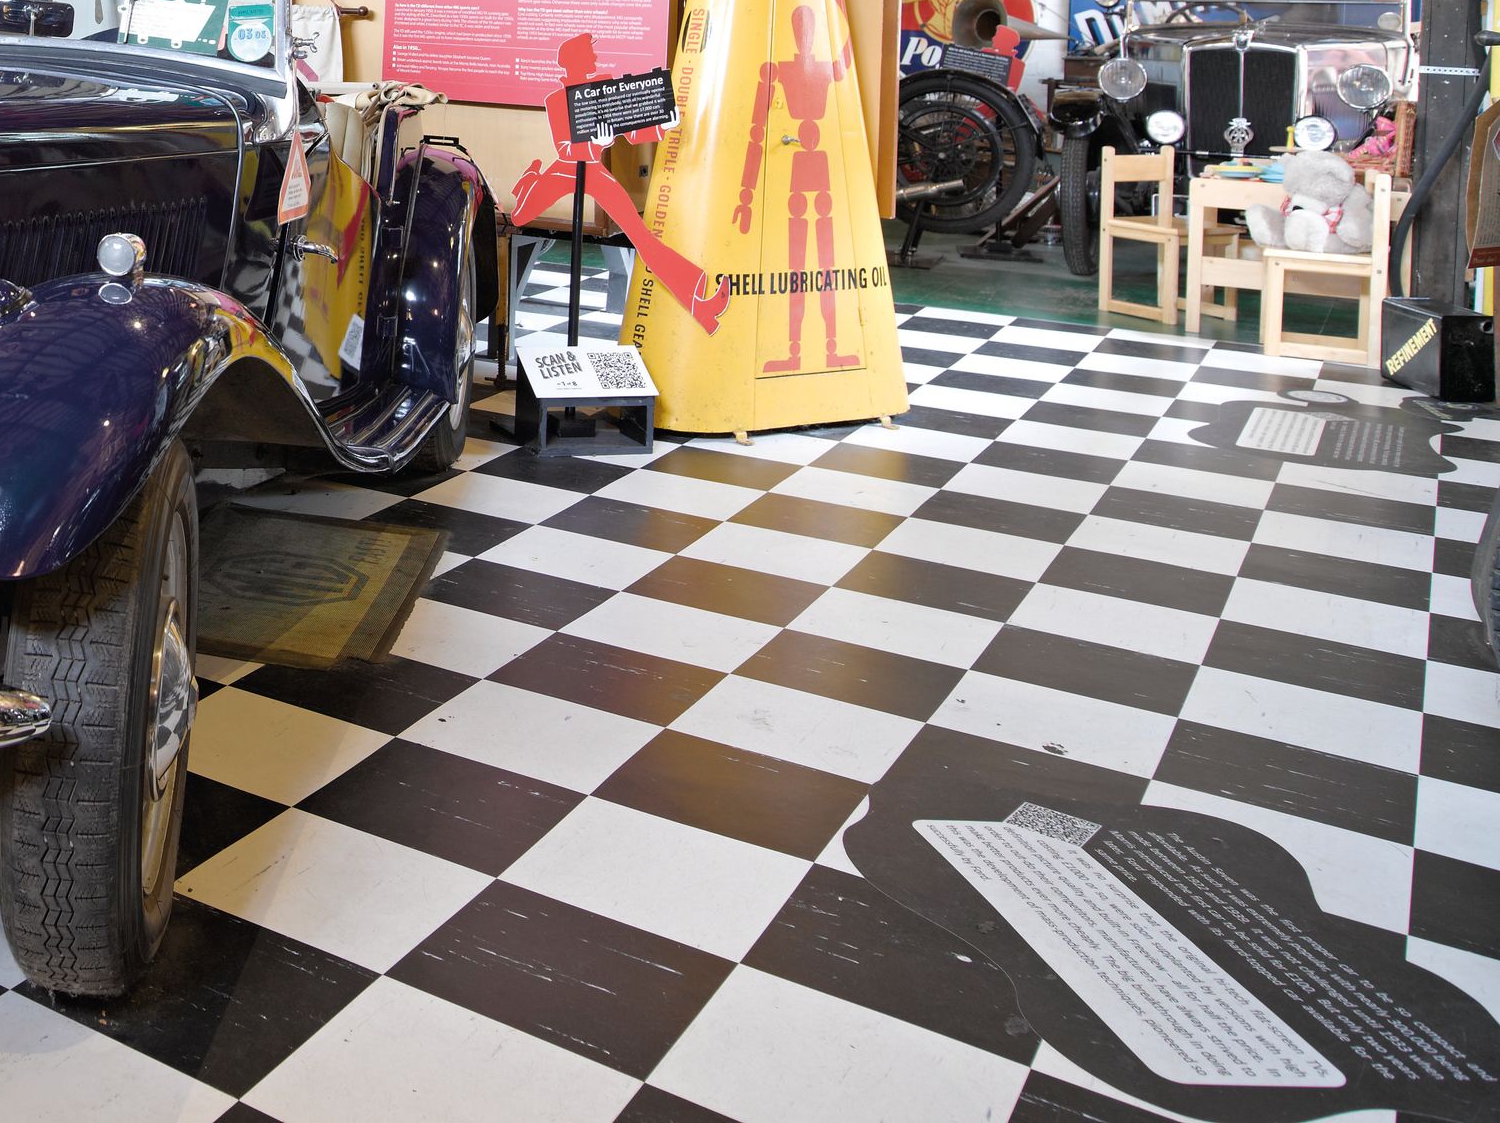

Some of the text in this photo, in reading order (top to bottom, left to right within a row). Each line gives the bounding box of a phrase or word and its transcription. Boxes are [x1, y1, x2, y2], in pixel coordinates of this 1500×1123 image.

[691, 8, 705, 55] SINGLE
[574, 76, 664, 101] A Car for Everyone
[652, 184, 672, 238] GOLDEN
[639, 277, 655, 318] SHELL
[769, 267, 868, 295] LUBRICATING
[871, 266, 887, 288] OIL
[535, 351, 577, 368] SCAN &
[1385, 317, 1438, 376] REFINEMENT
[540, 362, 583, 379] LISTEN
[1160, 929, 1178, 943] the
[1240, 888, 1260, 902] was
[1260, 904, 1278, 917] the
[1300, 936, 1339, 961] proper
[1338, 963, 1360, 977] car
[1413, 1021, 1467, 1060] compact
[1467, 1063, 1499, 1082] and
